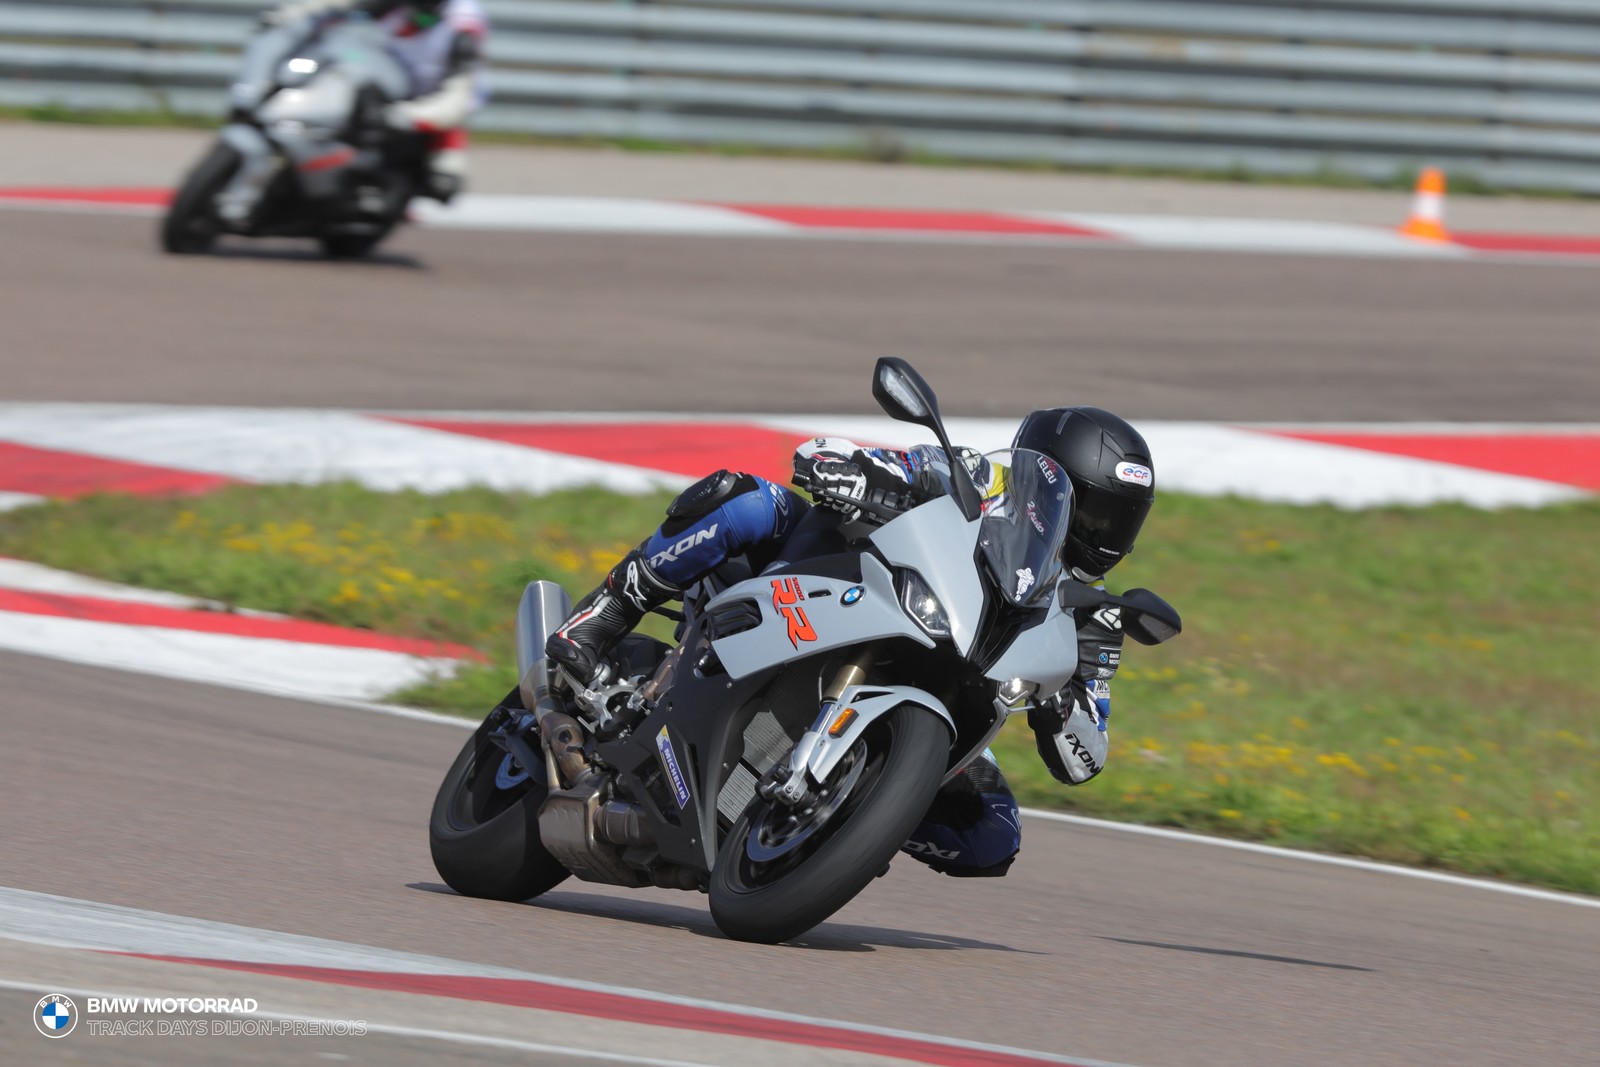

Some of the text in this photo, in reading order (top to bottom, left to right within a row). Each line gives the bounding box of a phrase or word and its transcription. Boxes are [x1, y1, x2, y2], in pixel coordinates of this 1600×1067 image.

[1037, 456, 1057, 484] LELEU
[770, 577, 818, 652] RR
[664, 748, 687, 800] MICHELIN
